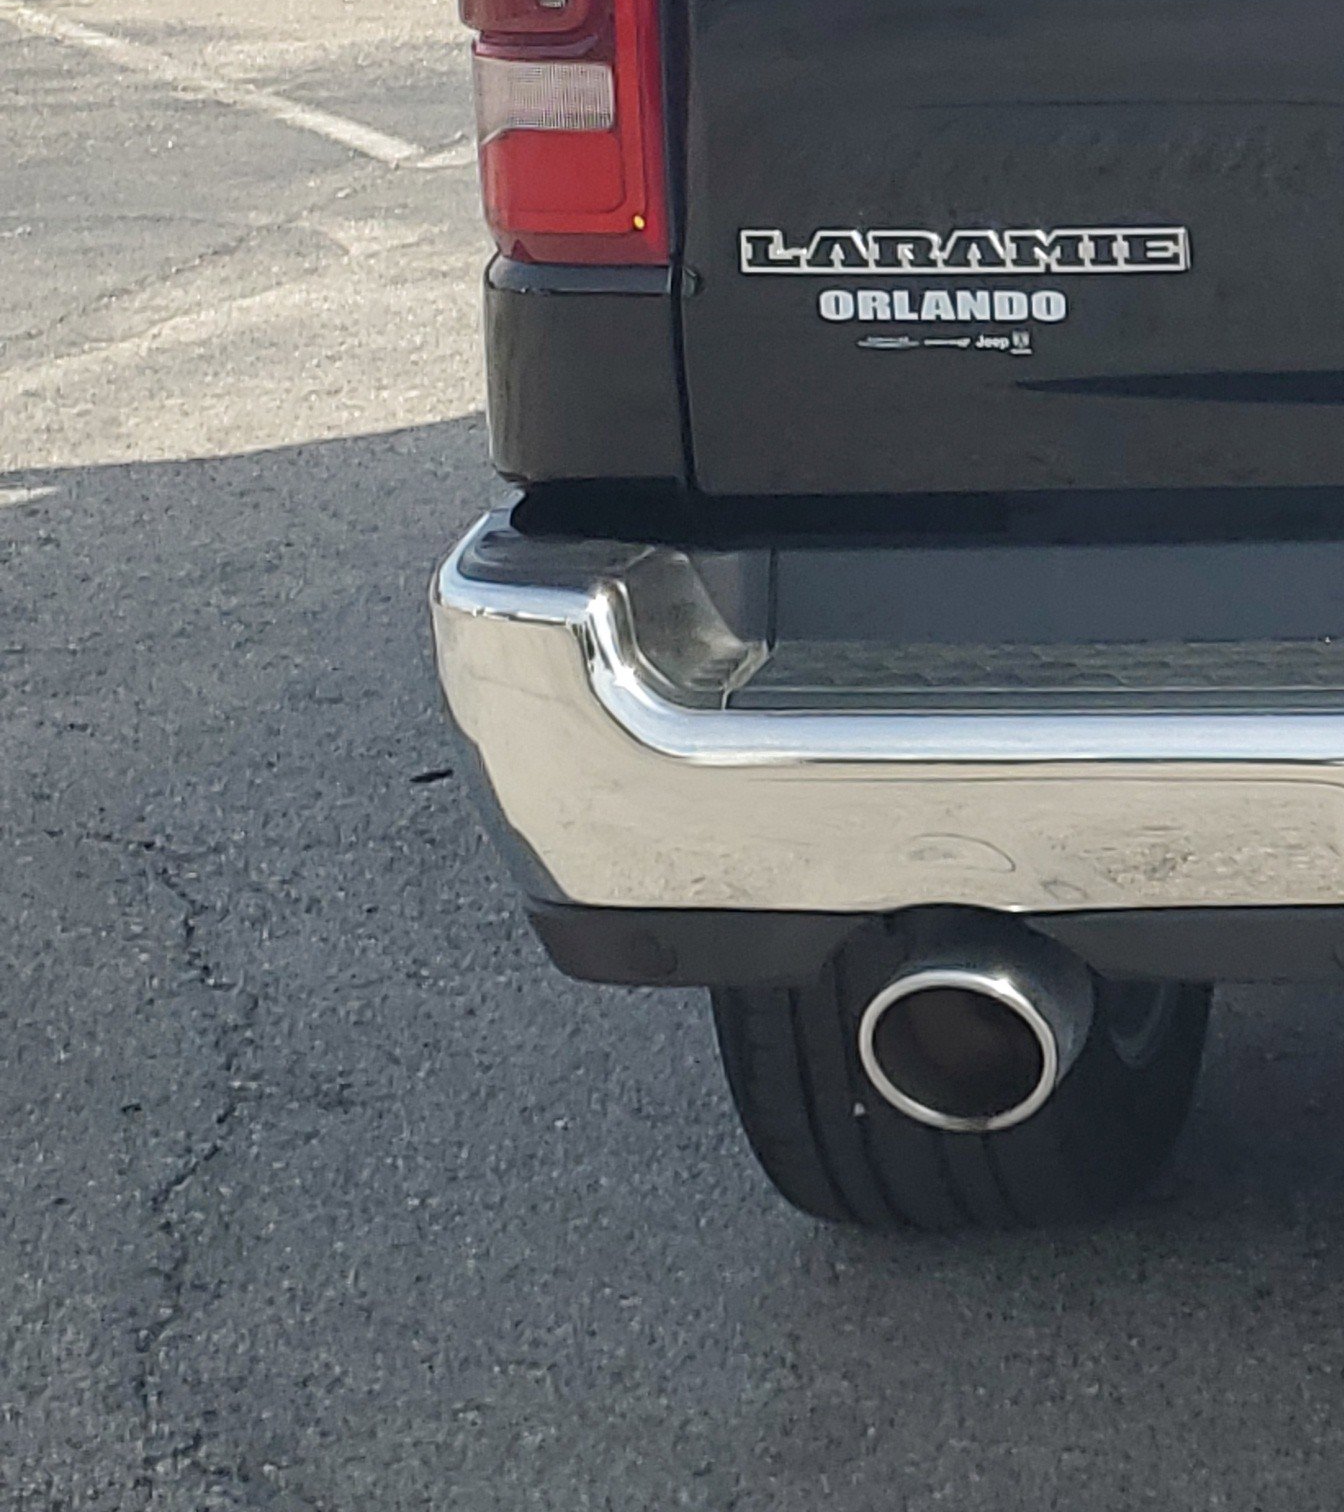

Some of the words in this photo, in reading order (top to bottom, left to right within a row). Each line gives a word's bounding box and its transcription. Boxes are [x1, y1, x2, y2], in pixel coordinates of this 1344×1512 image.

[741, 228, 1190, 273] LARAMIE
[819, 290, 1067, 322] ORLANDO
[975, 335, 1010, 351] Jeep
